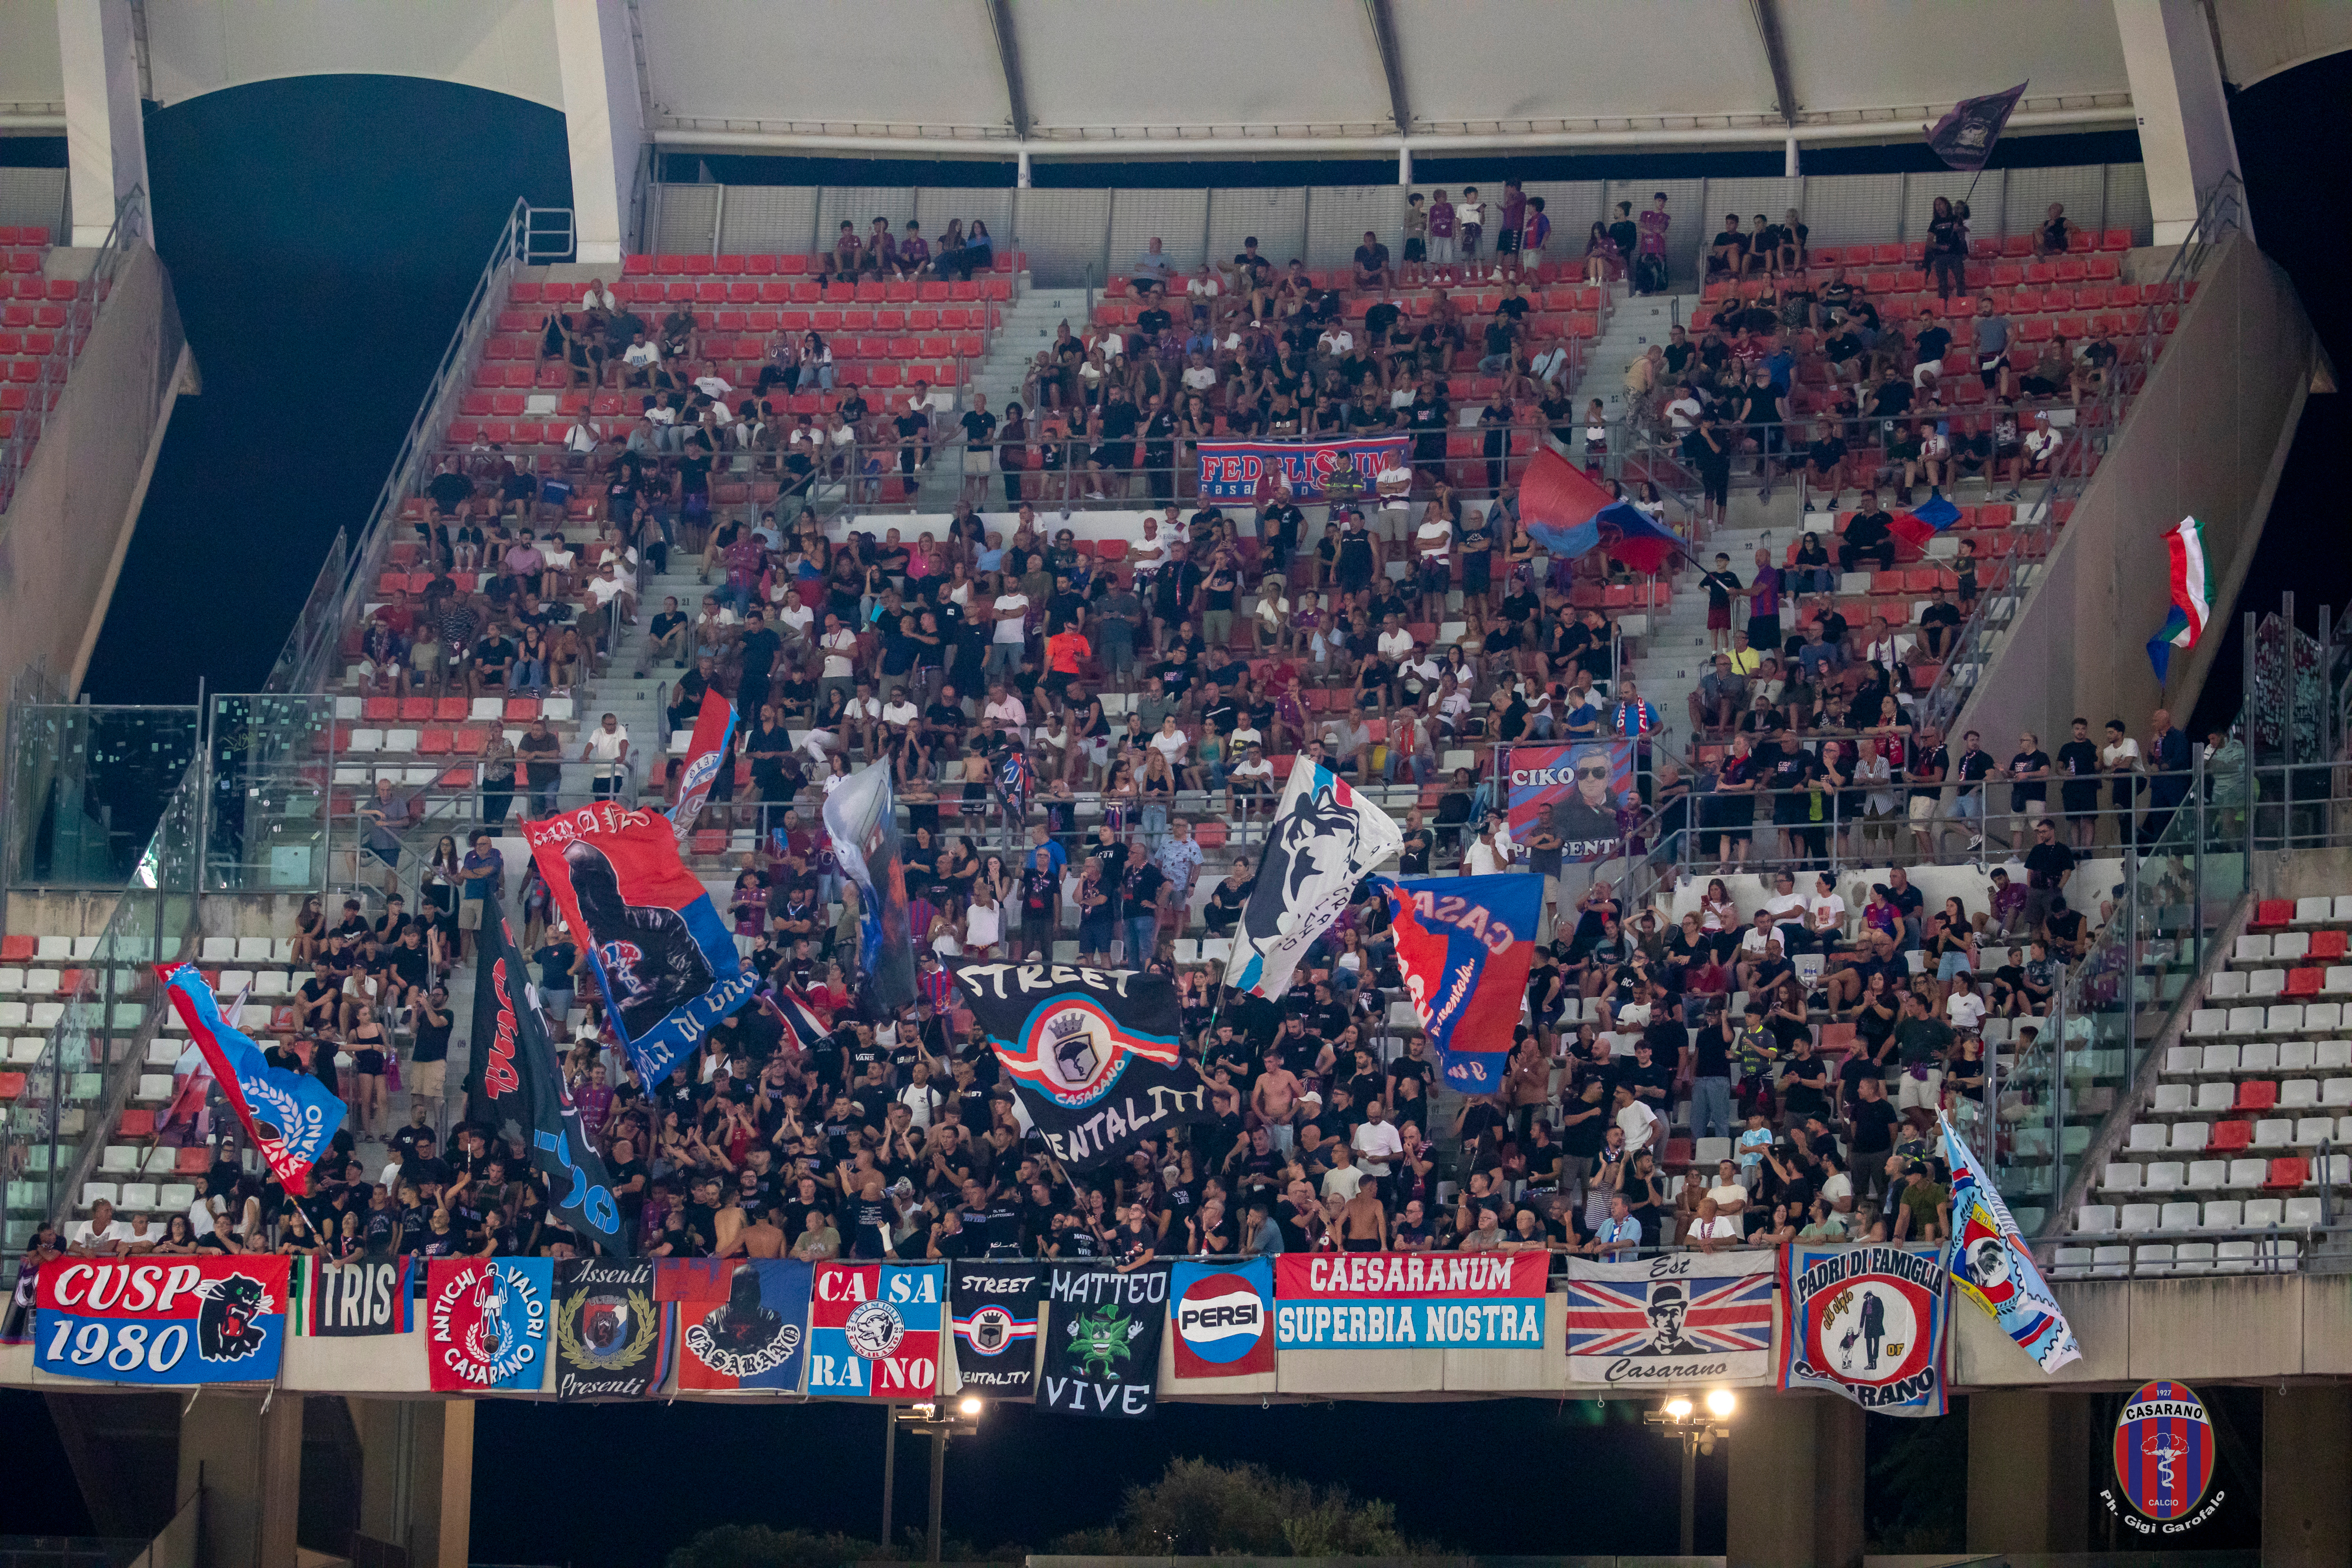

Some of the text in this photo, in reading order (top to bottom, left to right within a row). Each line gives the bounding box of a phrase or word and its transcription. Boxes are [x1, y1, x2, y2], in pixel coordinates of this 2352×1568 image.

[1677, 670, 1685, 678] 18
[637, 692, 644, 700] 18
[1511, 767, 1575, 787] CIKO
[957, 964, 1140, 999] STREET
[458, 1039, 466, 1048] 09
[1055, 1059, 1125, 1105] CASARANO
[1041, 1085, 1205, 1162] ENTALITY
[275, 1105, 323, 1180] SARANO
[1078, 1248, 1092, 1256] VIVE
[1649, 1255, 1691, 1278] Est
[54, 1264, 201, 1312] CUSP
[570, 1259, 652, 1284] Assenti
[818, 1271, 937, 1303] CA SA
[961, 1275, 1035, 1293] STREET
[1050, 1269, 1167, 1304] MATTEO
[1310, 1257, 1515, 1292] CAESARANUM
[1796, 1247, 1943, 1305] PADRI DI FAMIGLIA
[323, 1263, 396, 1326] TRIS
[434, 1268, 476, 1342] ANTICHI
[507, 1266, 543, 1339] VALORI
[588, 1295, 628, 1307] ULTRAS
[850, 1302, 901, 1325] CANI SCIOLTI
[1182, 1303, 1258, 1330] PERSI
[1278, 1305, 1539, 1343] SUPERBIA NOSTRA
[47, 1320, 188, 1372] 1980
[579, 1345, 627, 1363] CASARANO
[686, 1324, 800, 1378] CASARANO
[849, 1335, 899, 1358] CASARANO
[1886, 1343, 1905, 1356] OF
[445, 1344, 534, 1385] CASARANO
[810, 1355, 935, 1389] RA NO
[1605, 1358, 1728, 1382] Casarano
[560, 1372, 646, 1398] Presenti
[1046, 1376, 1150, 1414] VIVE
[1794, 1360, 1935, 1407] CRANO
